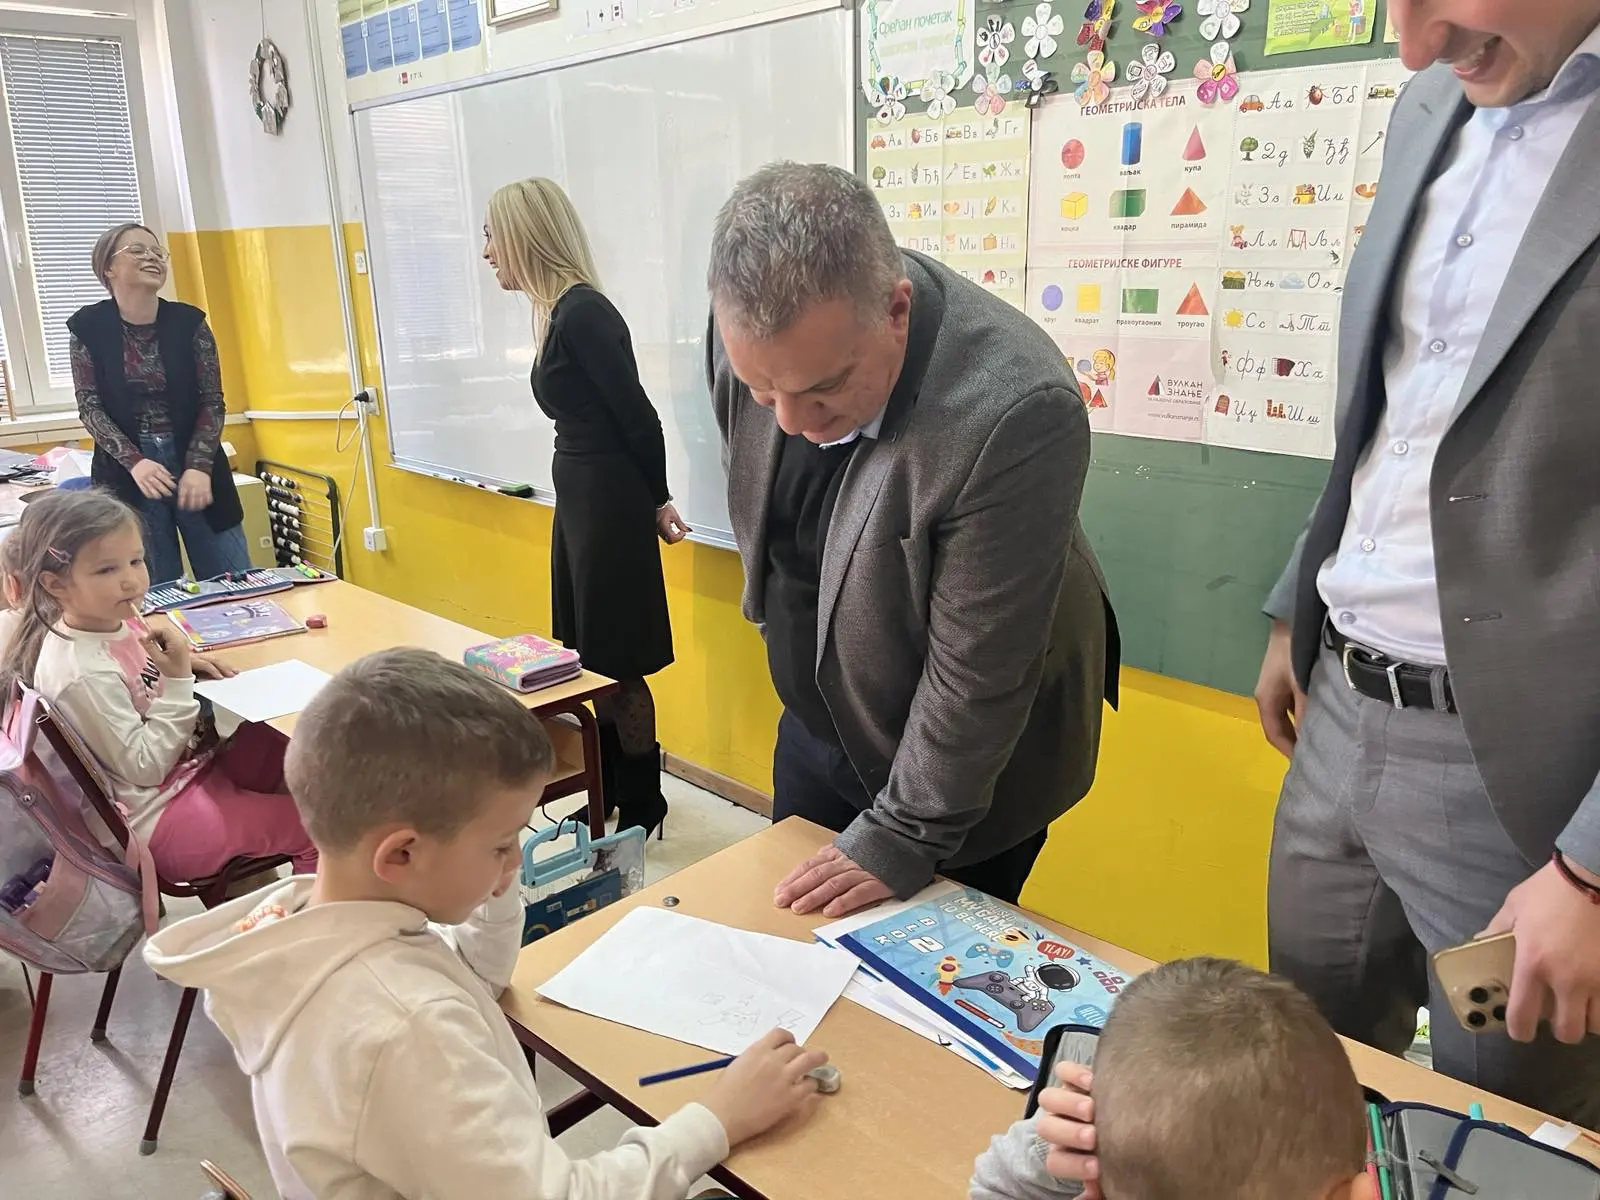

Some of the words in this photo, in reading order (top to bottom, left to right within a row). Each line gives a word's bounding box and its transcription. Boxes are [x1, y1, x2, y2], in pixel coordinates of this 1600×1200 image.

[914, 11, 953, 29] почетак
[1080, 98, 1156, 116] ГЕОМЕТРИЈСКА
[1159, 95, 1186, 109] ТЕЛА
[1184, 165, 1202, 173] купа
[1170, 222, 1208, 230] пирамида
[1068, 258, 1139, 269] ГЕОМЕТРИЈСКЕ
[1141, 258, 1182, 268] ФИГУРЕ
[1167, 379, 1203, 388] ВУЛКАН
[1167, 388, 1203, 398] ЗНАЊЕ
[954, 896, 982, 911] MY
[939, 901, 958, 913] TO
[955, 912, 976, 924] BE
[972, 922, 1004, 942] HERE
[1044, 943, 1072, 957] YEAY!
